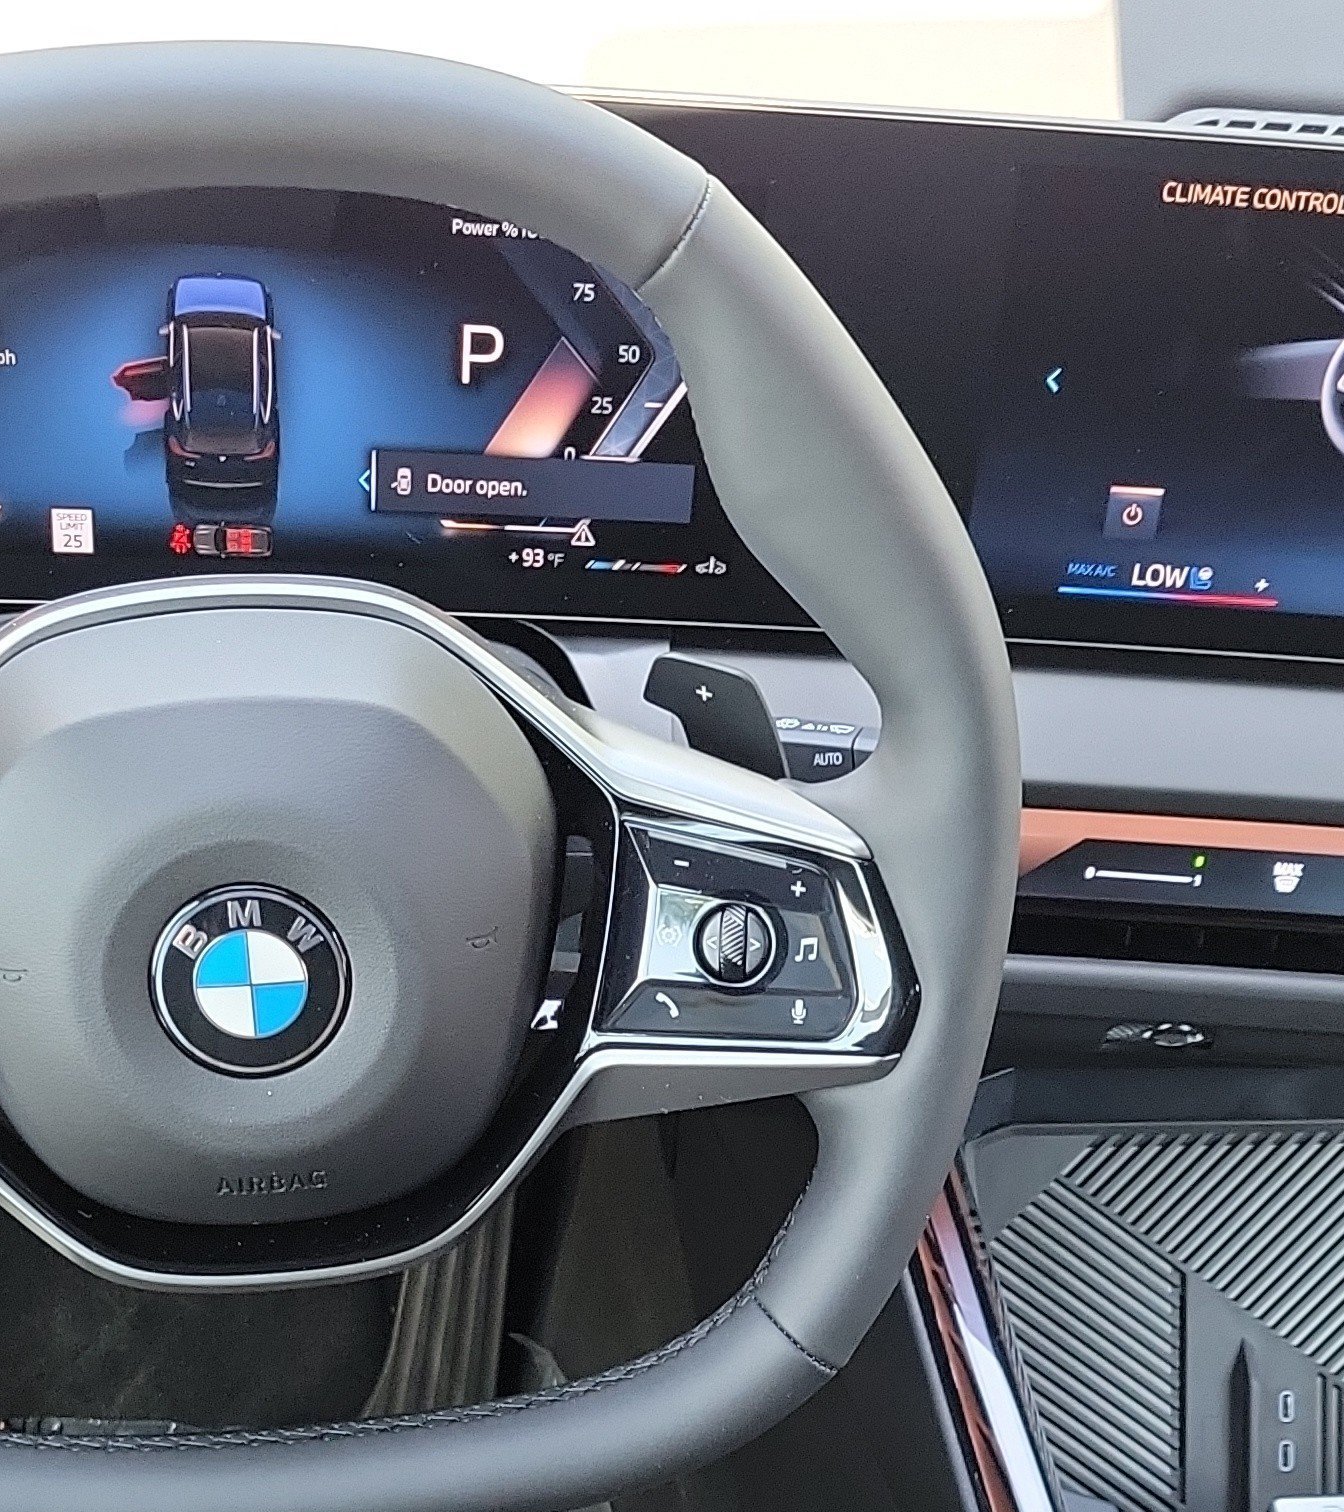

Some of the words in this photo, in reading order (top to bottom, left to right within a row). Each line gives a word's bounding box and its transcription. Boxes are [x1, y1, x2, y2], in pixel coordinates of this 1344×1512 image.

[1161, 180, 1251, 208] CLIMATE
[451, 217, 500, 237] Power
[572, 282, 595, 301] 75
[460, 323, 505, 385] P
[617, 344, 641, 365] 50
[590, 395, 613, 415] 25
[426, 472, 470, 496] Door
[473, 475, 528, 500] open.
[56, 512, 88, 522] SPEED
[59, 522, 84, 531] LIMIT
[62, 533, 83, 549] 25
[1130, 562, 1190, 588] LOW
[813, 751, 843, 768] AUTO
[172, 899, 325, 961] BMW
[215, 1169, 330, 1198] AIRBAG
